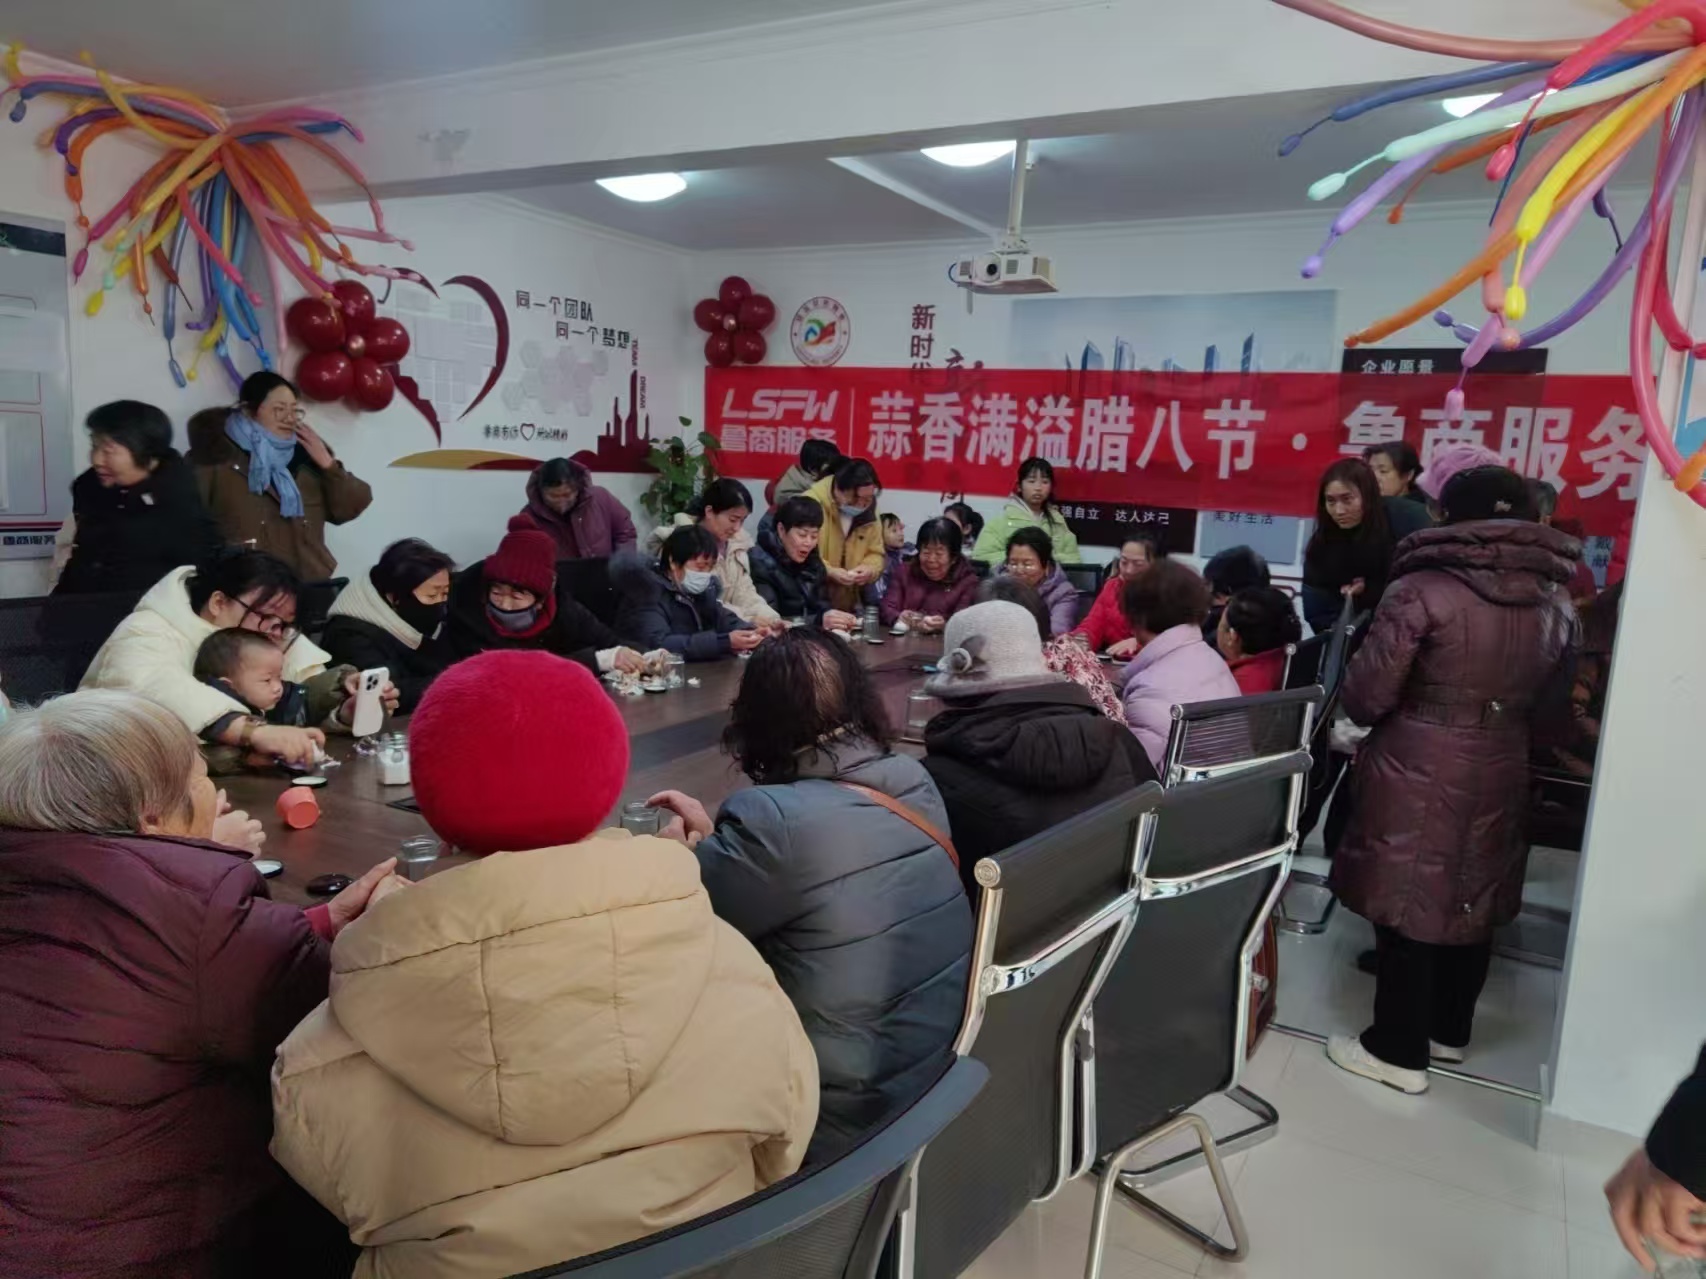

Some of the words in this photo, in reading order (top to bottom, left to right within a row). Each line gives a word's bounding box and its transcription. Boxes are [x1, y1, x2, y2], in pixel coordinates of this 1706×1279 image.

[516, 290, 593, 321] 同一个团队
[721, 388, 839, 422] LSFW
